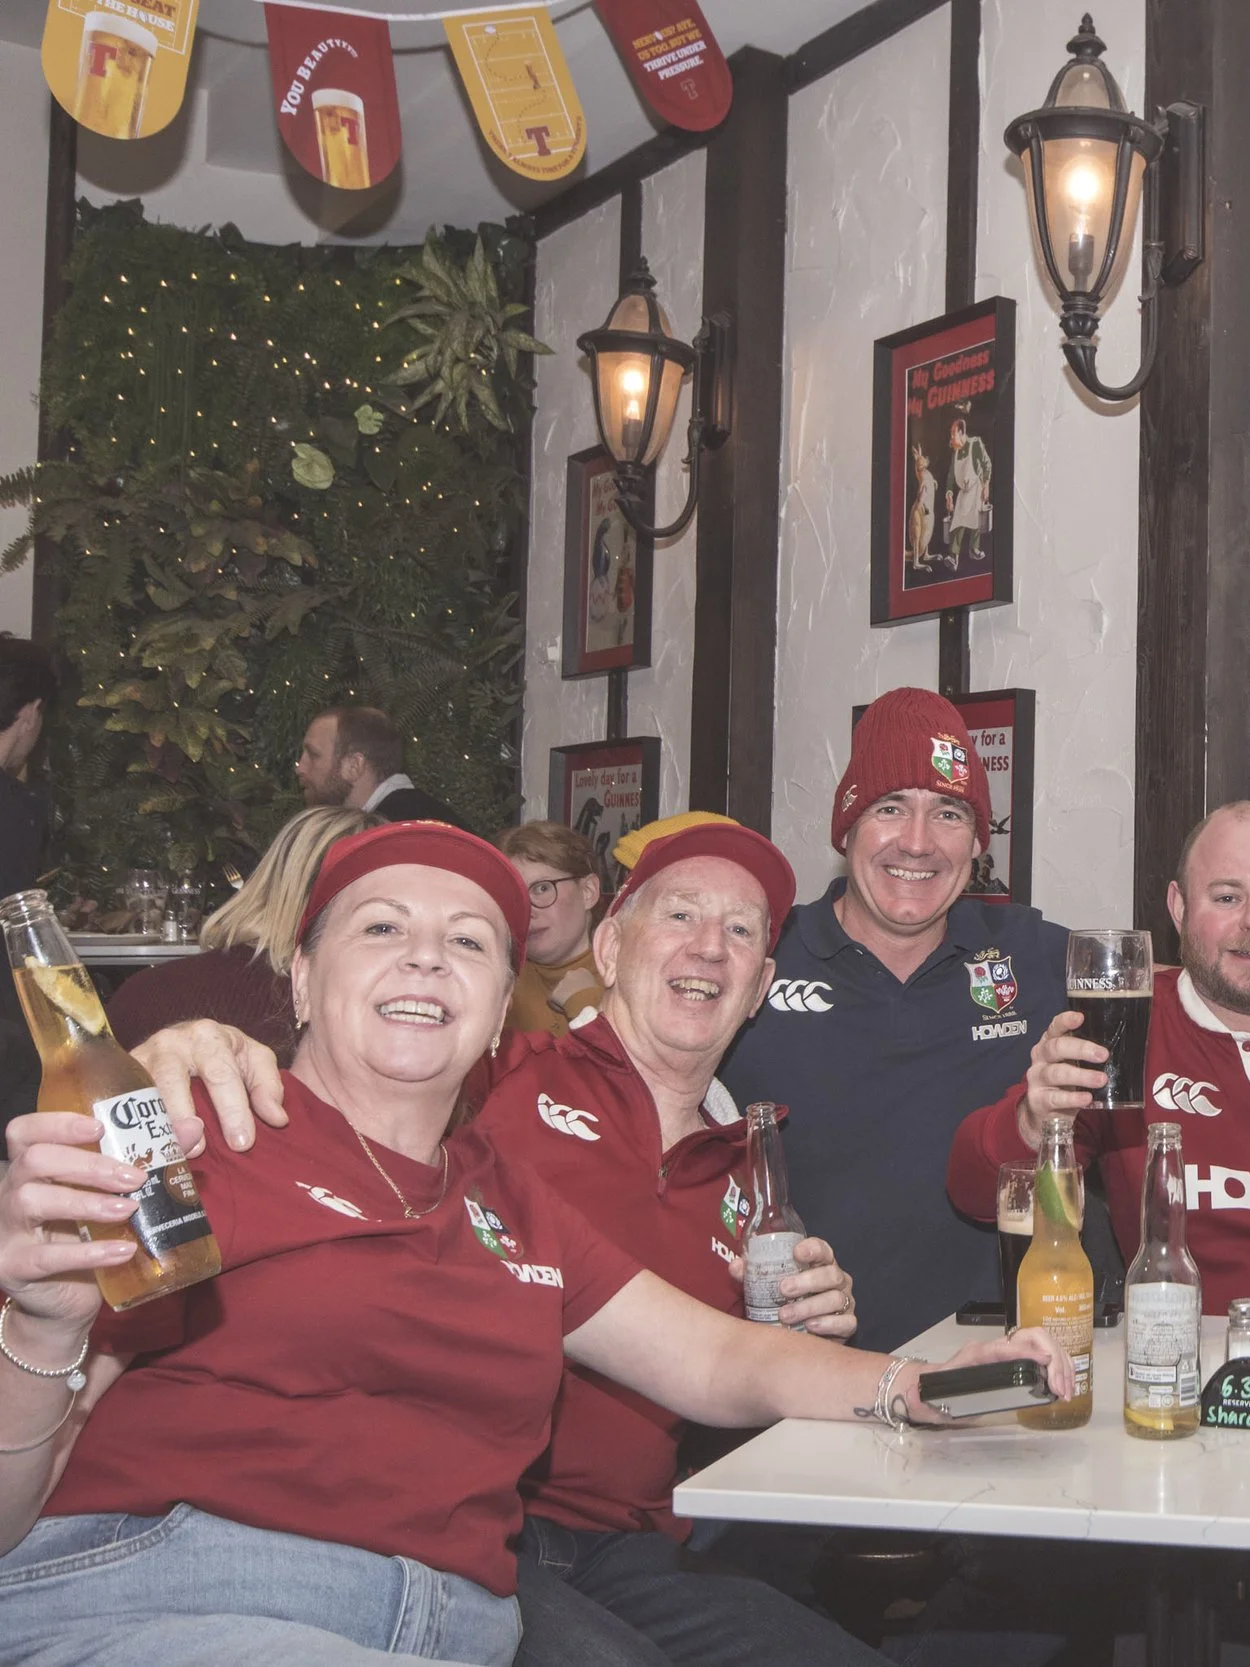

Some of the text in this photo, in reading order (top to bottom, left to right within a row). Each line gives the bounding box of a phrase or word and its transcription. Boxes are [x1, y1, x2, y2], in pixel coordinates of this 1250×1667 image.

[643, 40, 707, 73] THRIVE UNDER
[280, 80, 305, 116] YOU
[525, 126, 551, 157] T
[928, 368, 996, 410] GUINNESS
[981, 731, 996, 746] for
[998, 732, 1006, 745] a
[980, 756, 1009, 772] NESS
[971, 1019, 1028, 1041] HOWDEN
[145, 1120, 173, 1140] Ext
